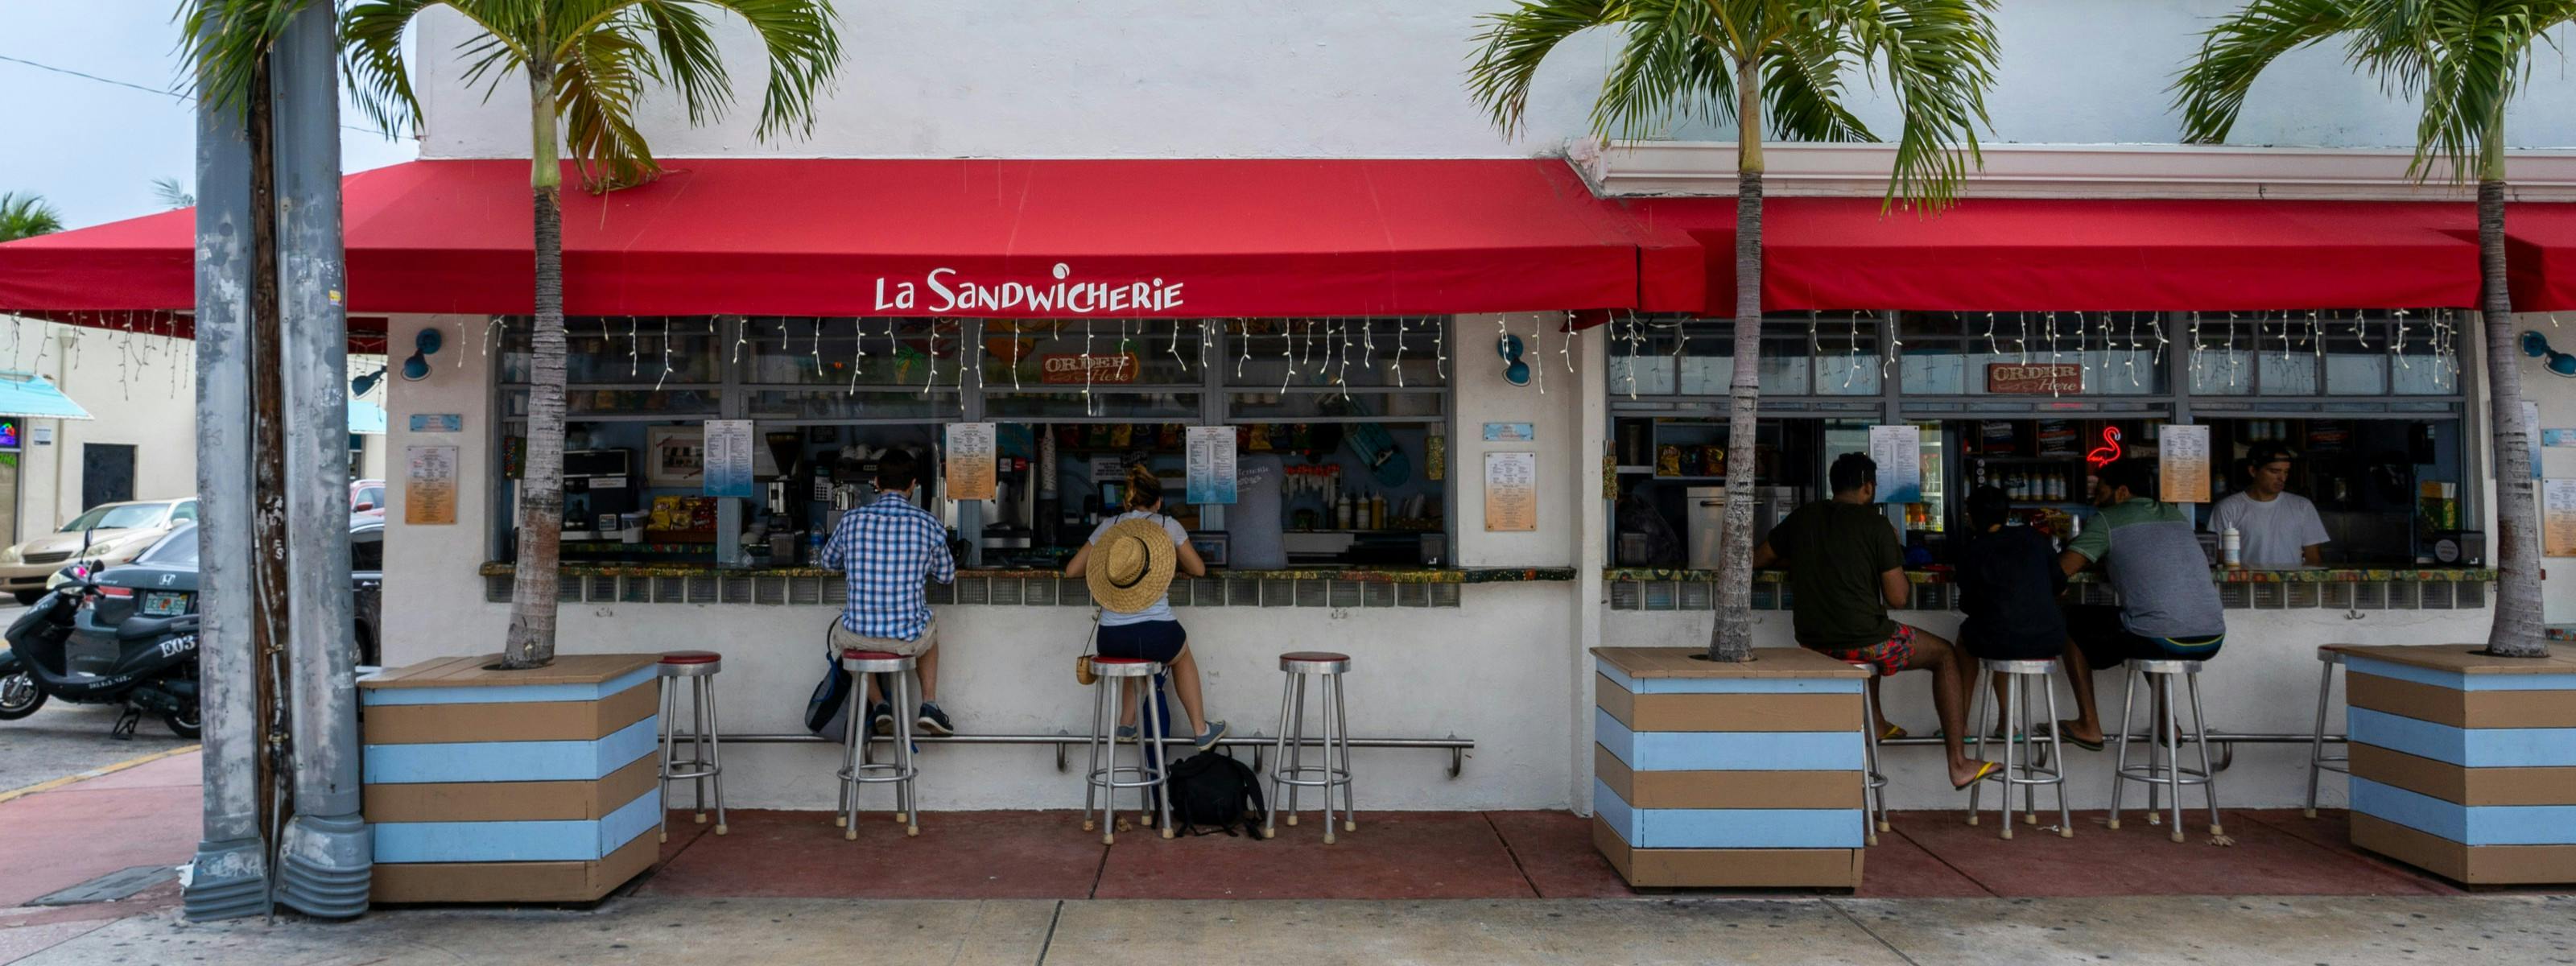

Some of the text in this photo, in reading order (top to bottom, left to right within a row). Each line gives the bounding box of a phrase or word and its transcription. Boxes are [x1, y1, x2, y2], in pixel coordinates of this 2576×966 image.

[875, 277, 914, 311] La
[1045, 356, 1129, 372] ORDER
[1993, 366, 2077, 381] ORDER
[2038, 378, 2077, 390] Here
[159, 634, 196, 658] E03
